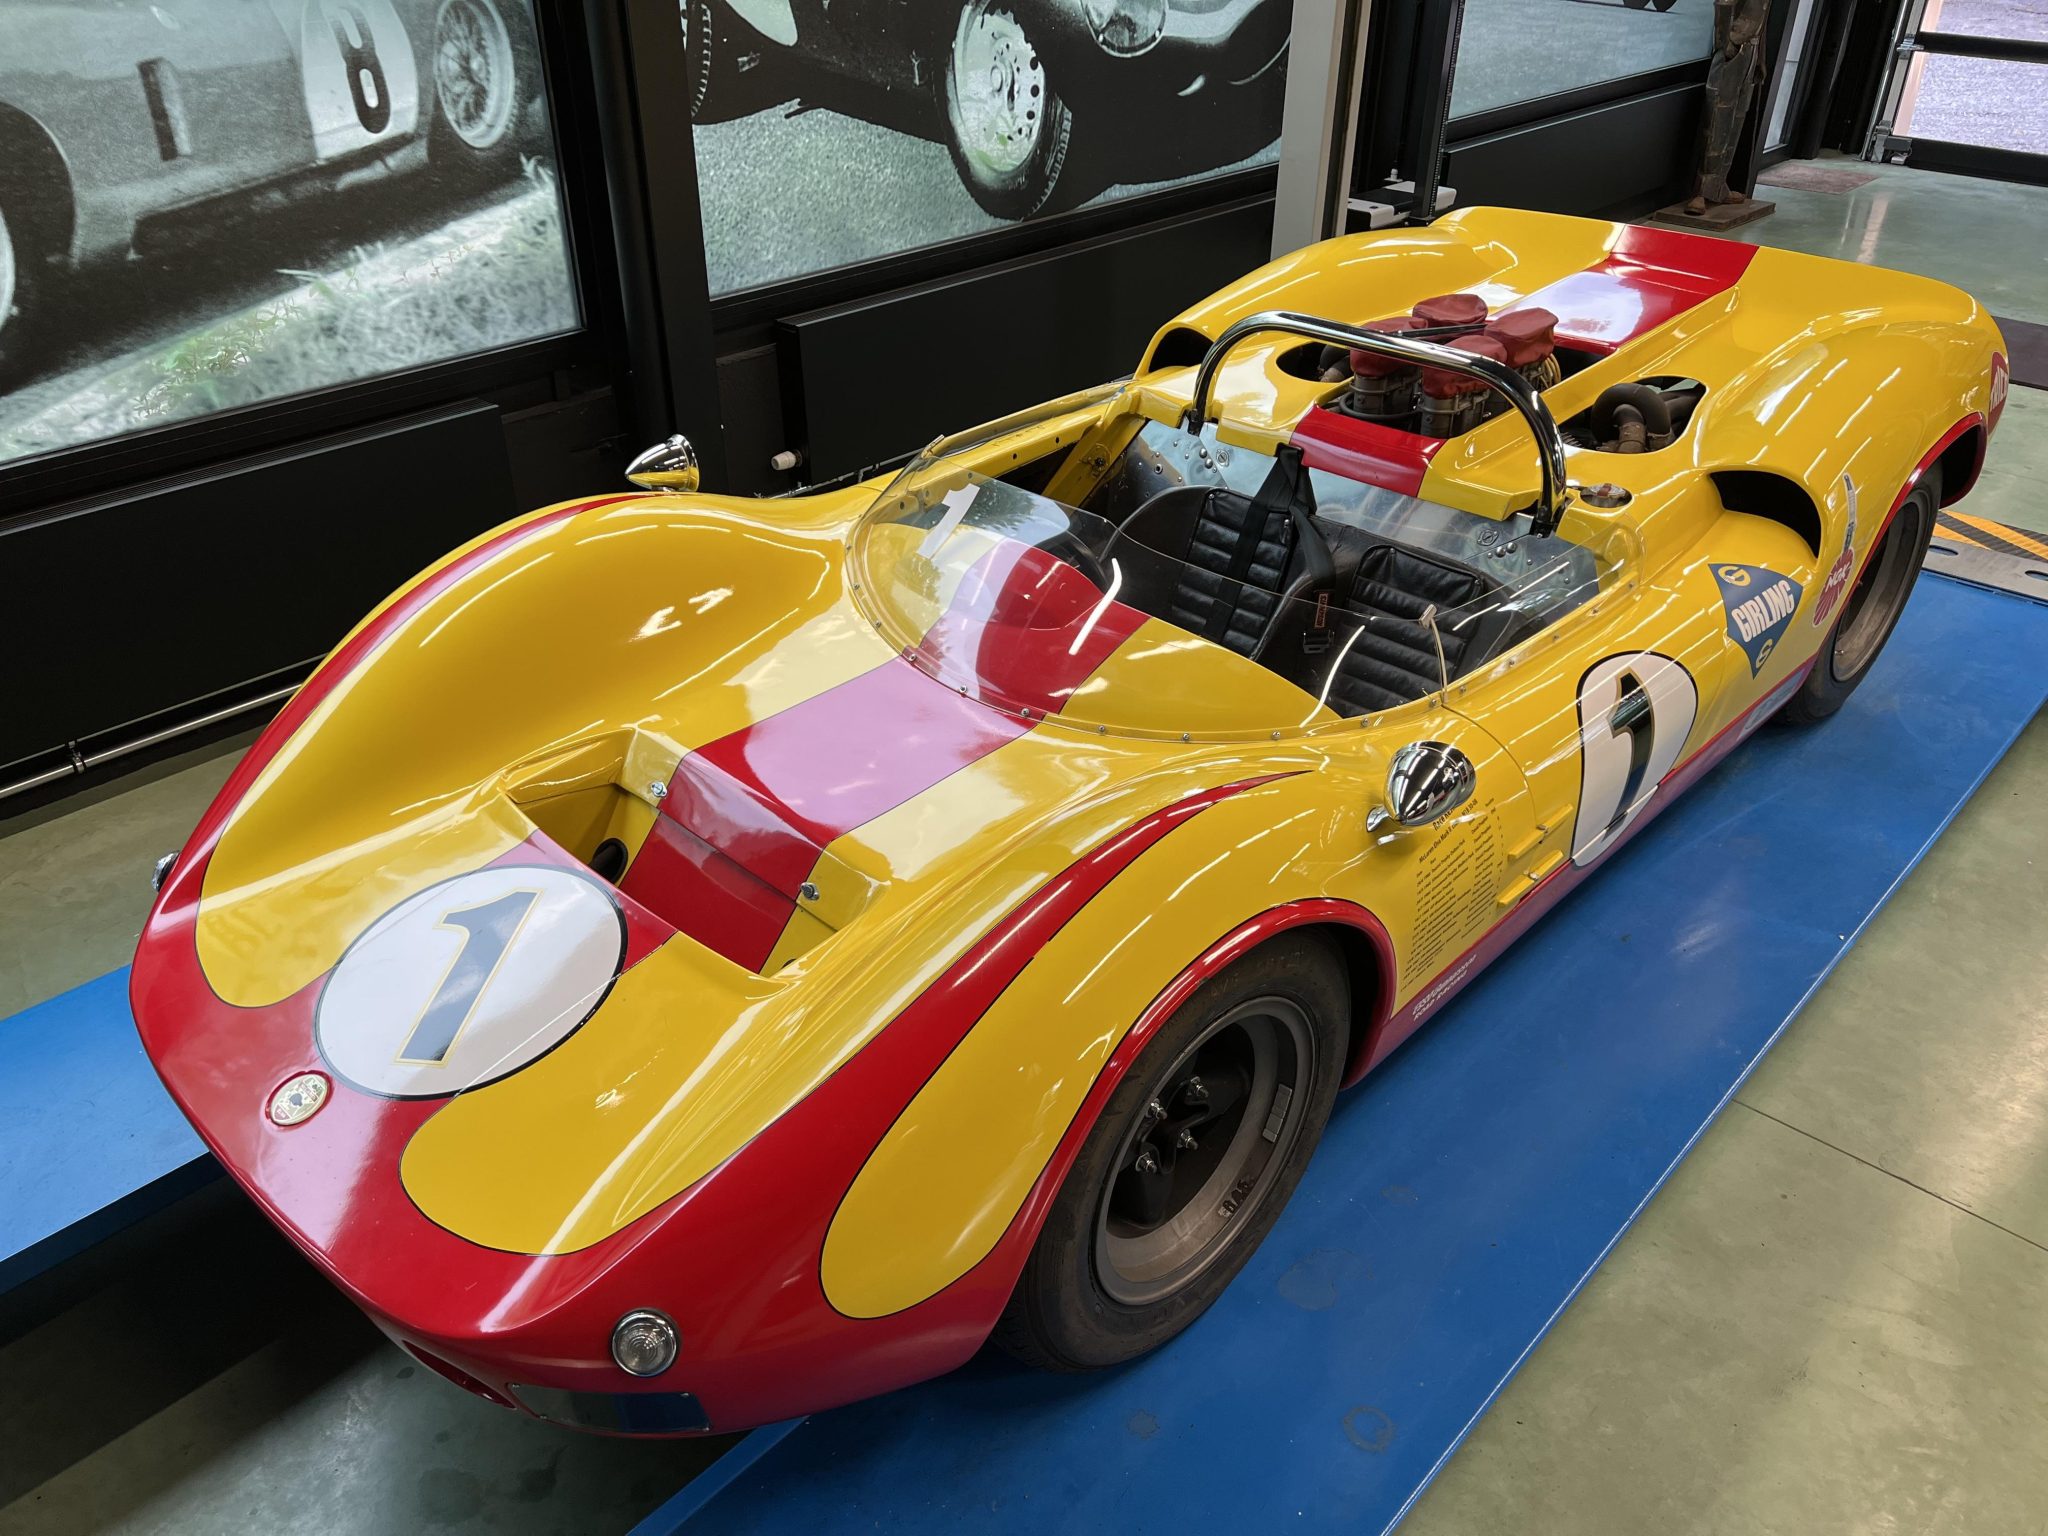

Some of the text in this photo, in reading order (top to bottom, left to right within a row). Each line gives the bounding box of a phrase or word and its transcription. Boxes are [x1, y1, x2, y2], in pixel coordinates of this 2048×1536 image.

[1731, 580, 1795, 643] GIRLING
[1825, 562, 1851, 592] NGK
[1602, 666, 1656, 844] 1
[395, 889, 543, 1067] 1
